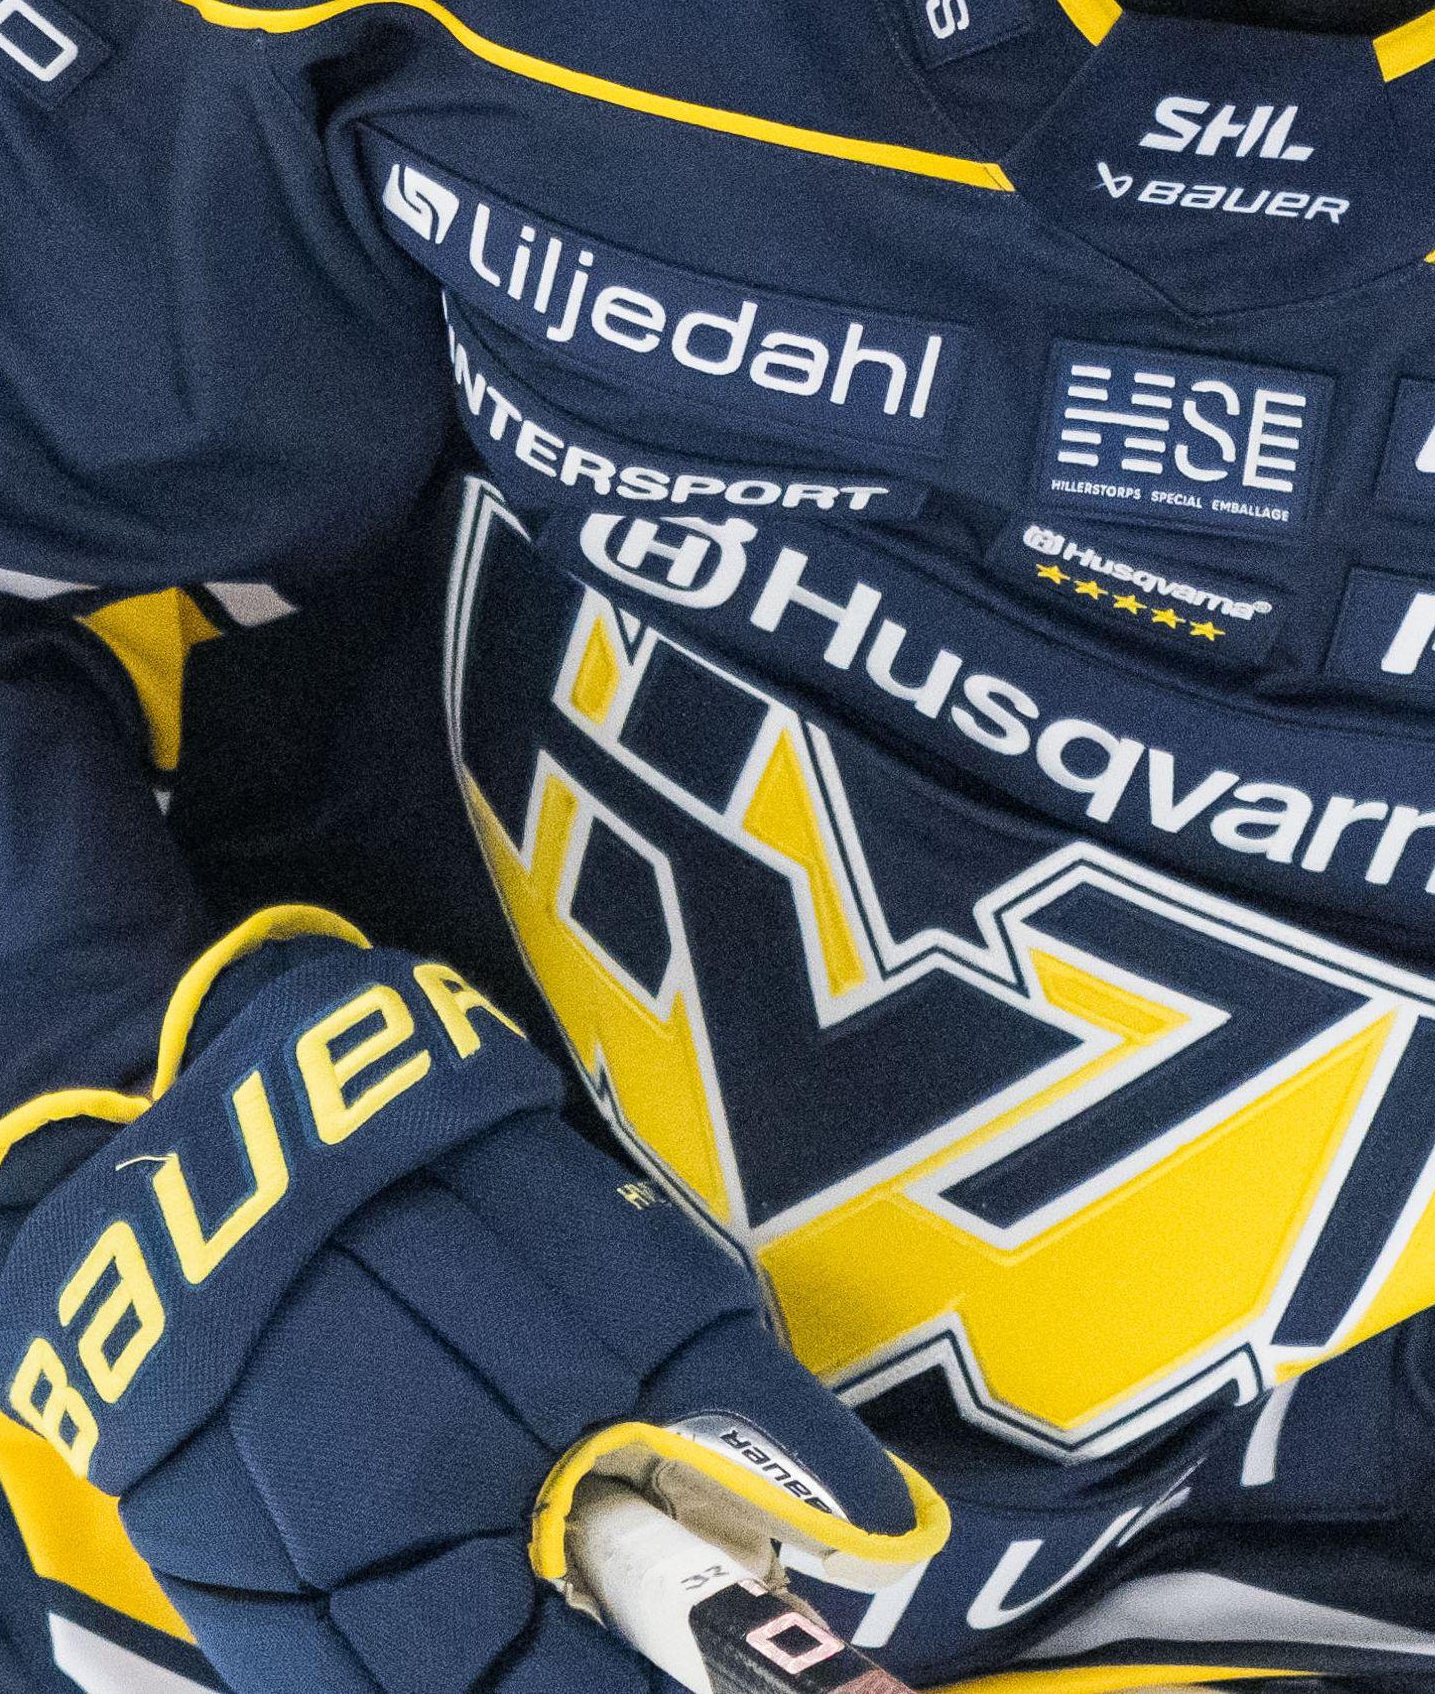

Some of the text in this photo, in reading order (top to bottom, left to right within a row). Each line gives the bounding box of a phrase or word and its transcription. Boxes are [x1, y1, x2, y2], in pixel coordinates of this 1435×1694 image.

[1139, 96, 1314, 161] SHL
[469, 202, 943, 419] Liljedahl
[1057, 364, 1307, 493] HSE
[1051, 479, 1290, 523] HILLERSTORPS SPECIAL EMBALLAGE
